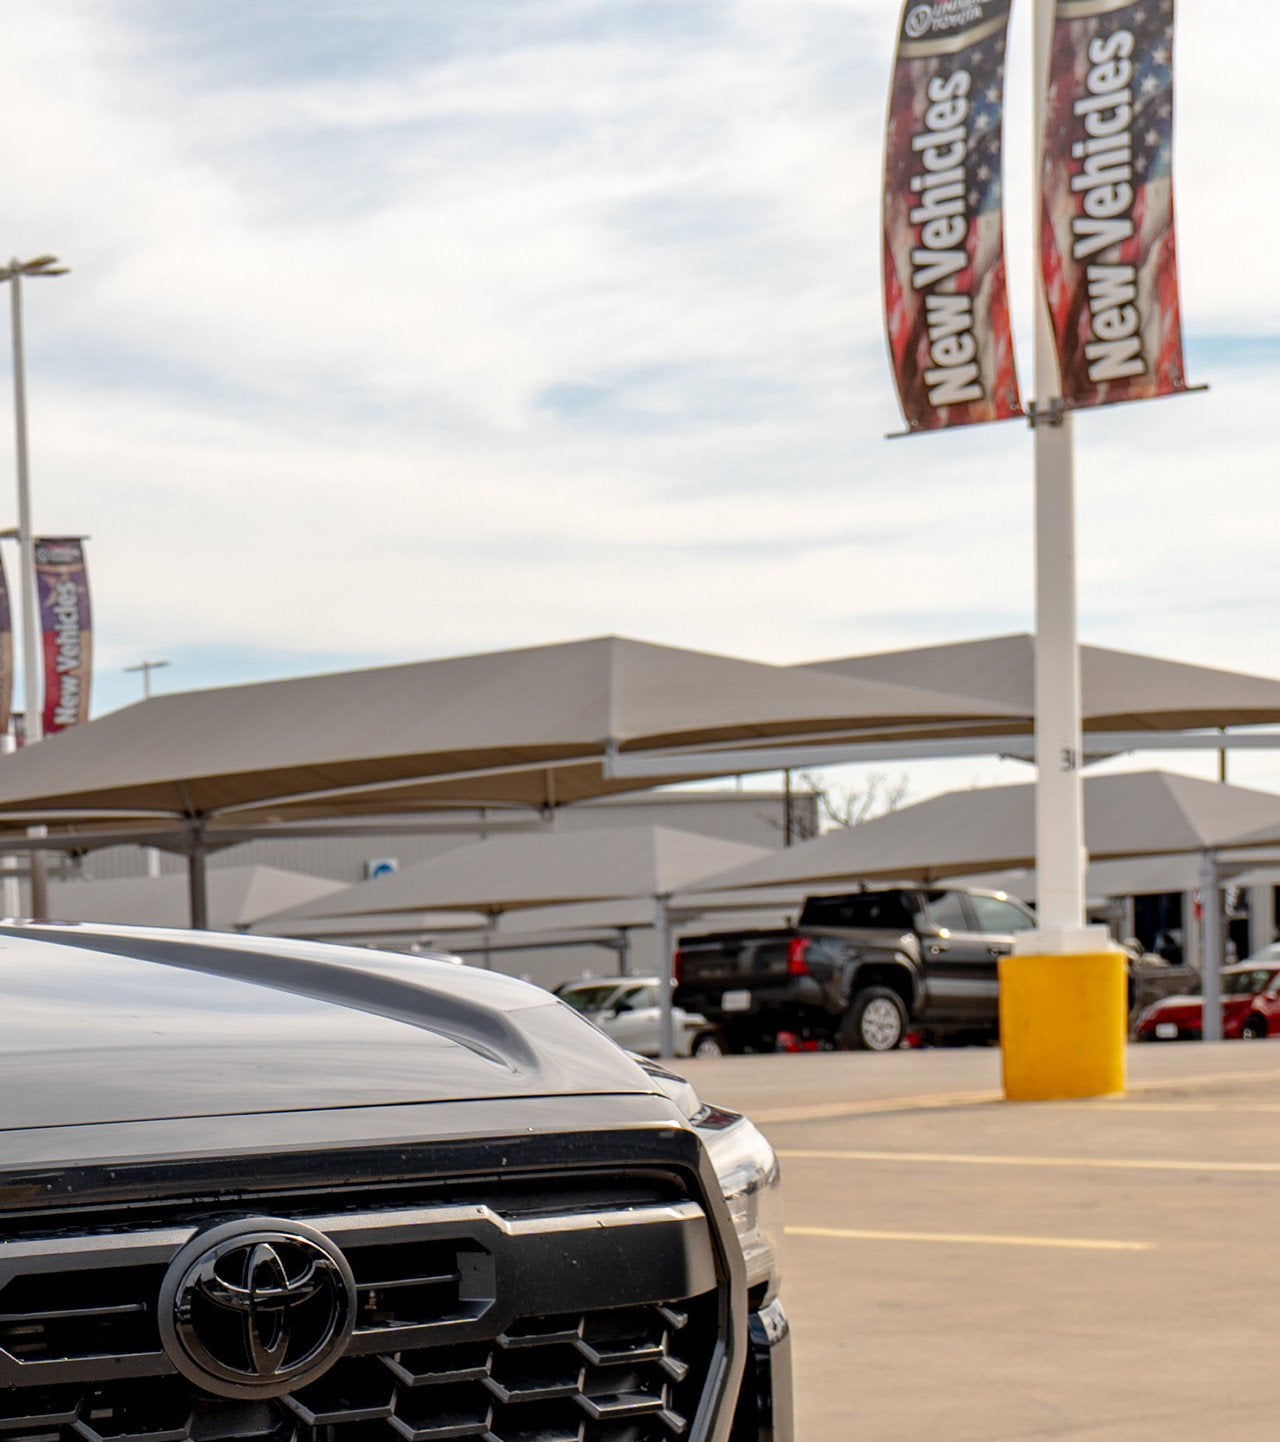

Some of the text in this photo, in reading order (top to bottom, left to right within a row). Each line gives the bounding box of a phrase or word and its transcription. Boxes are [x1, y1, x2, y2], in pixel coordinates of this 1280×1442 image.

[910, 69, 972, 289] Vehicles
[1072, 29, 1147, 383] New Vehicles
[924, 294, 985, 406] New
[52, 580, 81, 675] Vehicles
[53, 675, 82, 725] New
